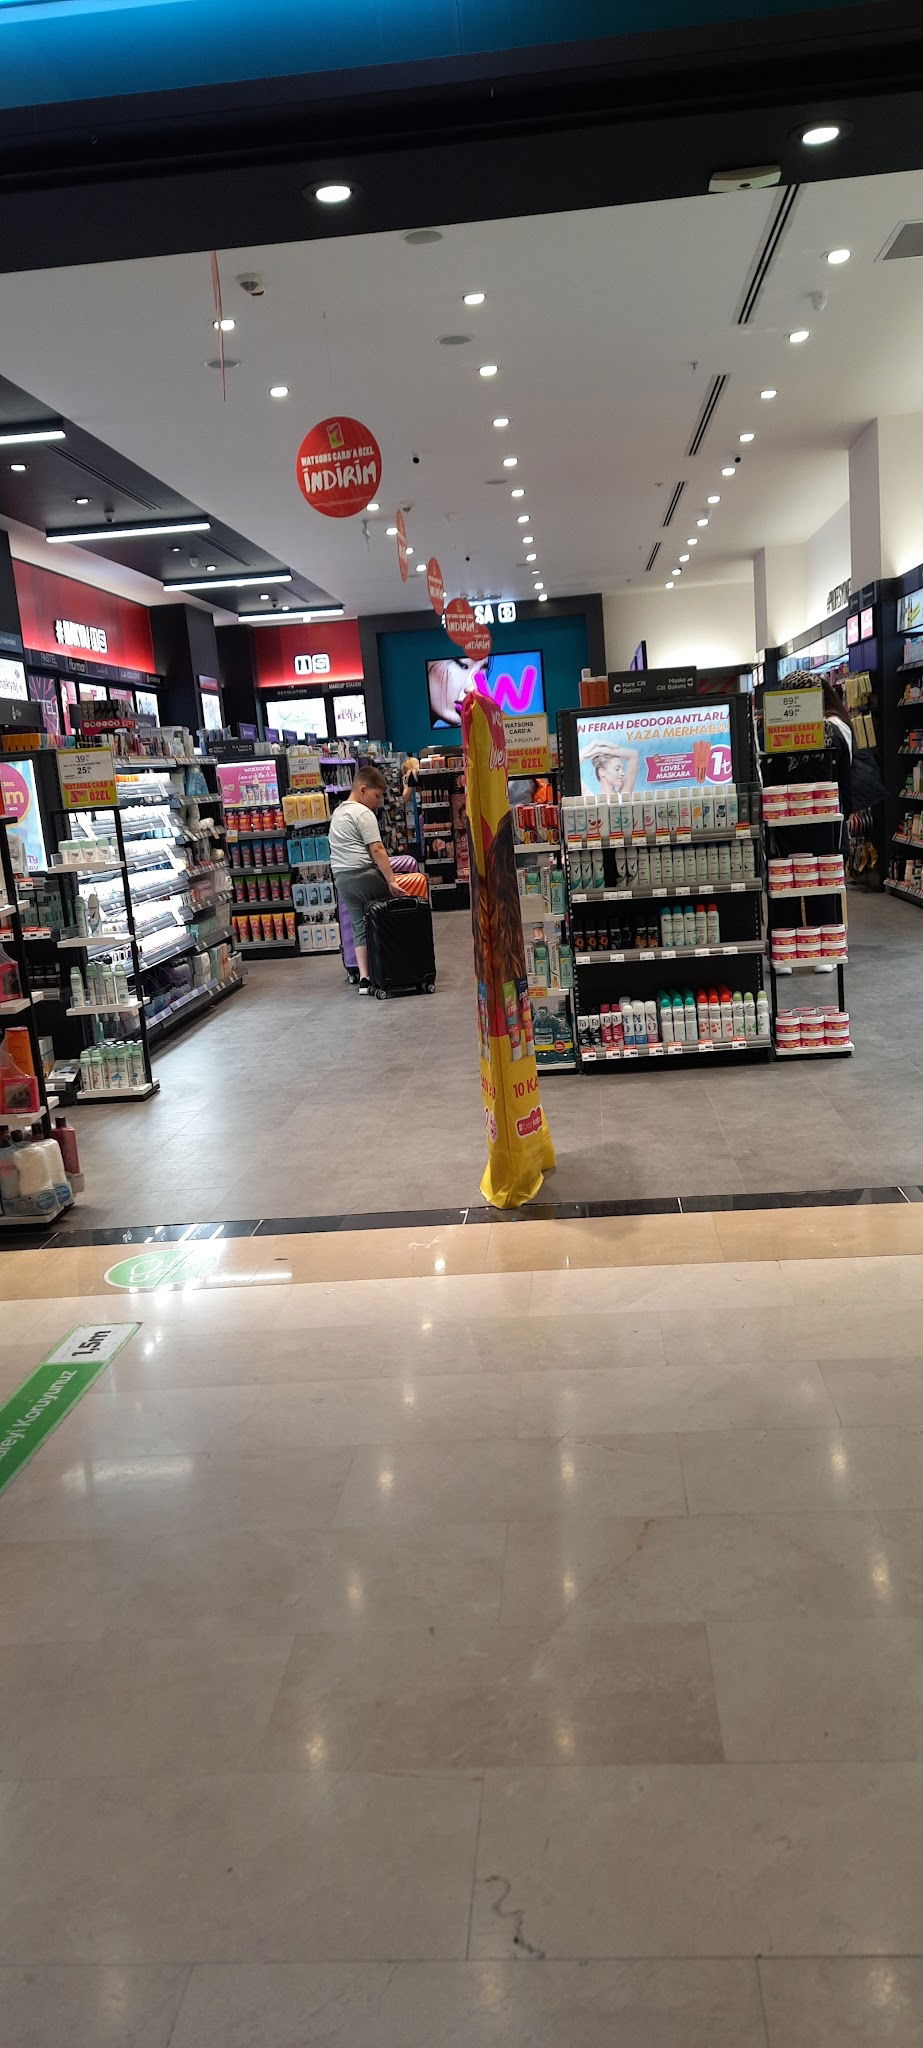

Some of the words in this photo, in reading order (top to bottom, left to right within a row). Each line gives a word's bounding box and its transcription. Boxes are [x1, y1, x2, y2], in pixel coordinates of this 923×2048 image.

[301, 452, 332, 466] WATSONS
[332, 448, 358, 461] CARD'A
[302, 459, 377, 494] İNDİRİM
[504, 721, 534, 729] WATSONS
[588, 720, 624, 732] FERAH
[626, 730, 660, 742] YAZA
[655, 770, 690, 779] MASKARA
[659, 763, 686, 772] LOVELY
[513, 1081, 525, 1098] 10
[71, 1330, 112, 1356] 1,5m
[12, 1370, 78, 1427] Koruyunuz
